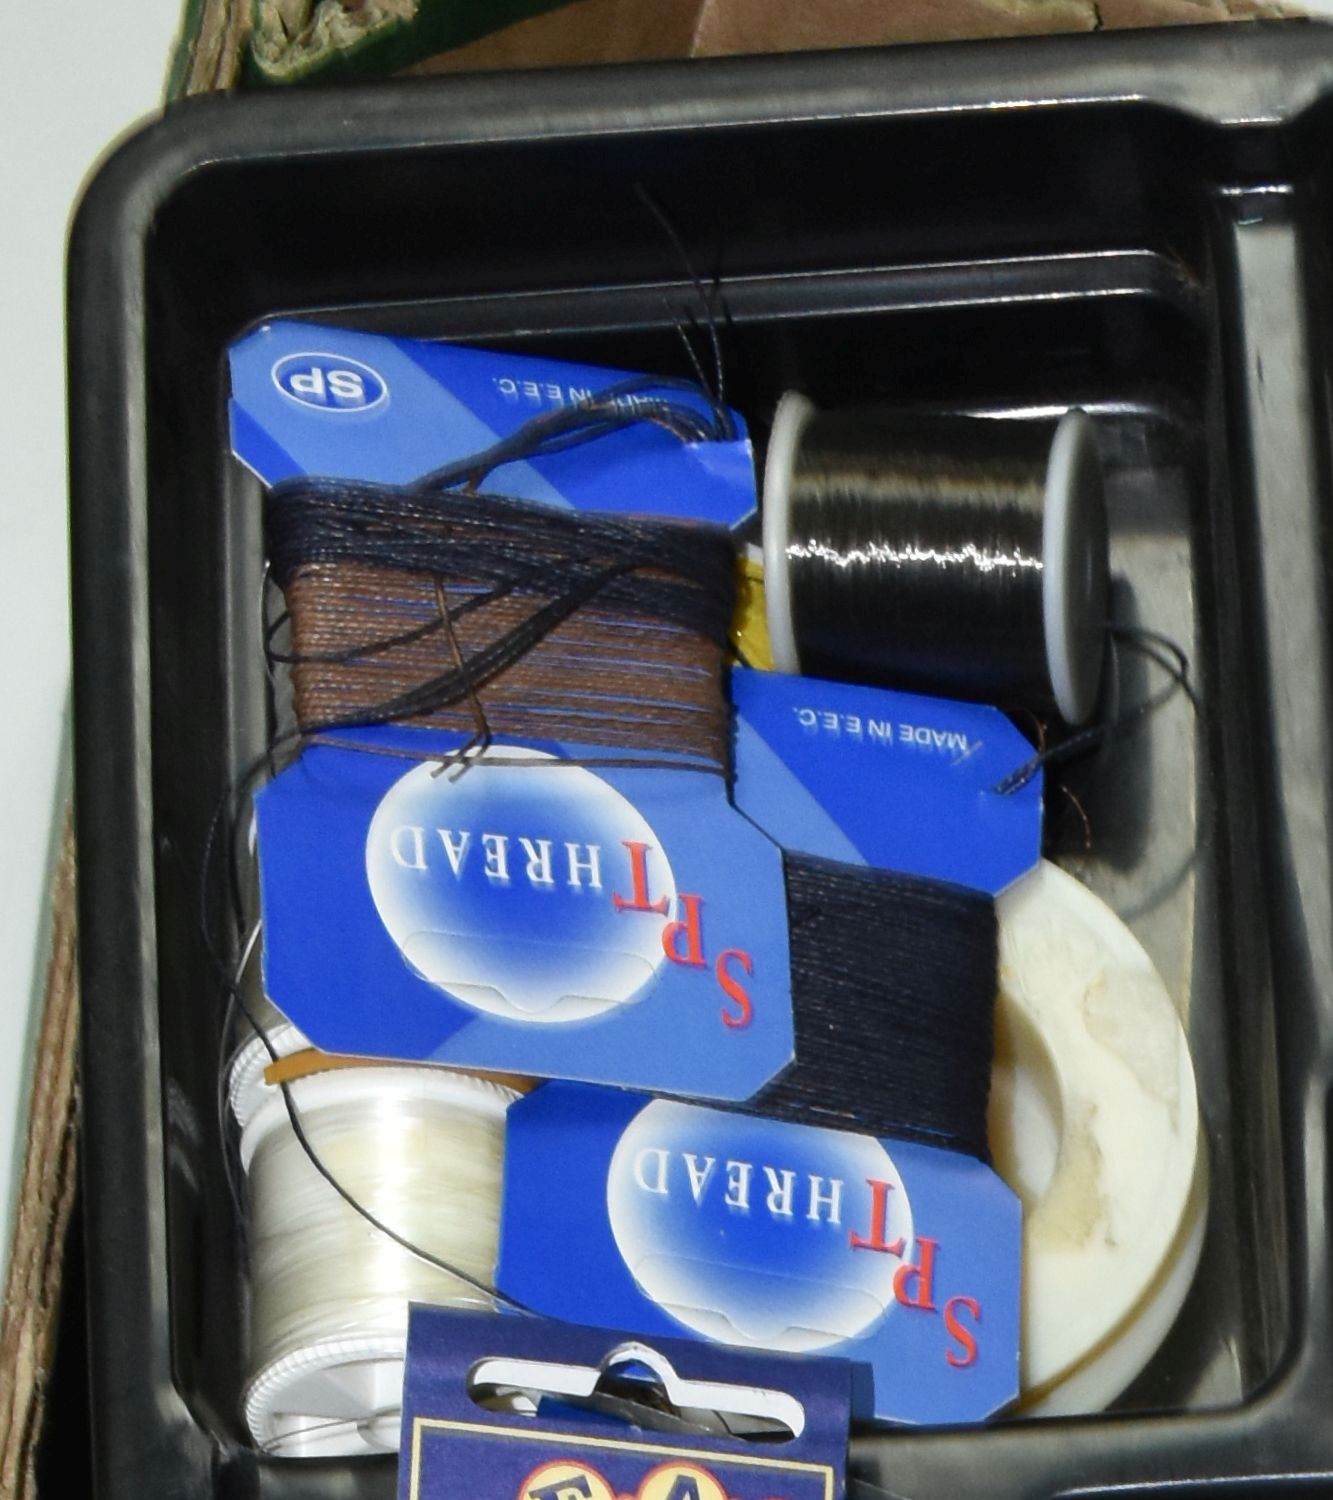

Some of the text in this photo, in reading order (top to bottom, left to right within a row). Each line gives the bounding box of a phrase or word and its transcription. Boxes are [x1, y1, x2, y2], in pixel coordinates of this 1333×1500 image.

[288, 369, 367, 402] SP
[866, 717, 894, 738] IN
[895, 722, 970, 751] MADE
